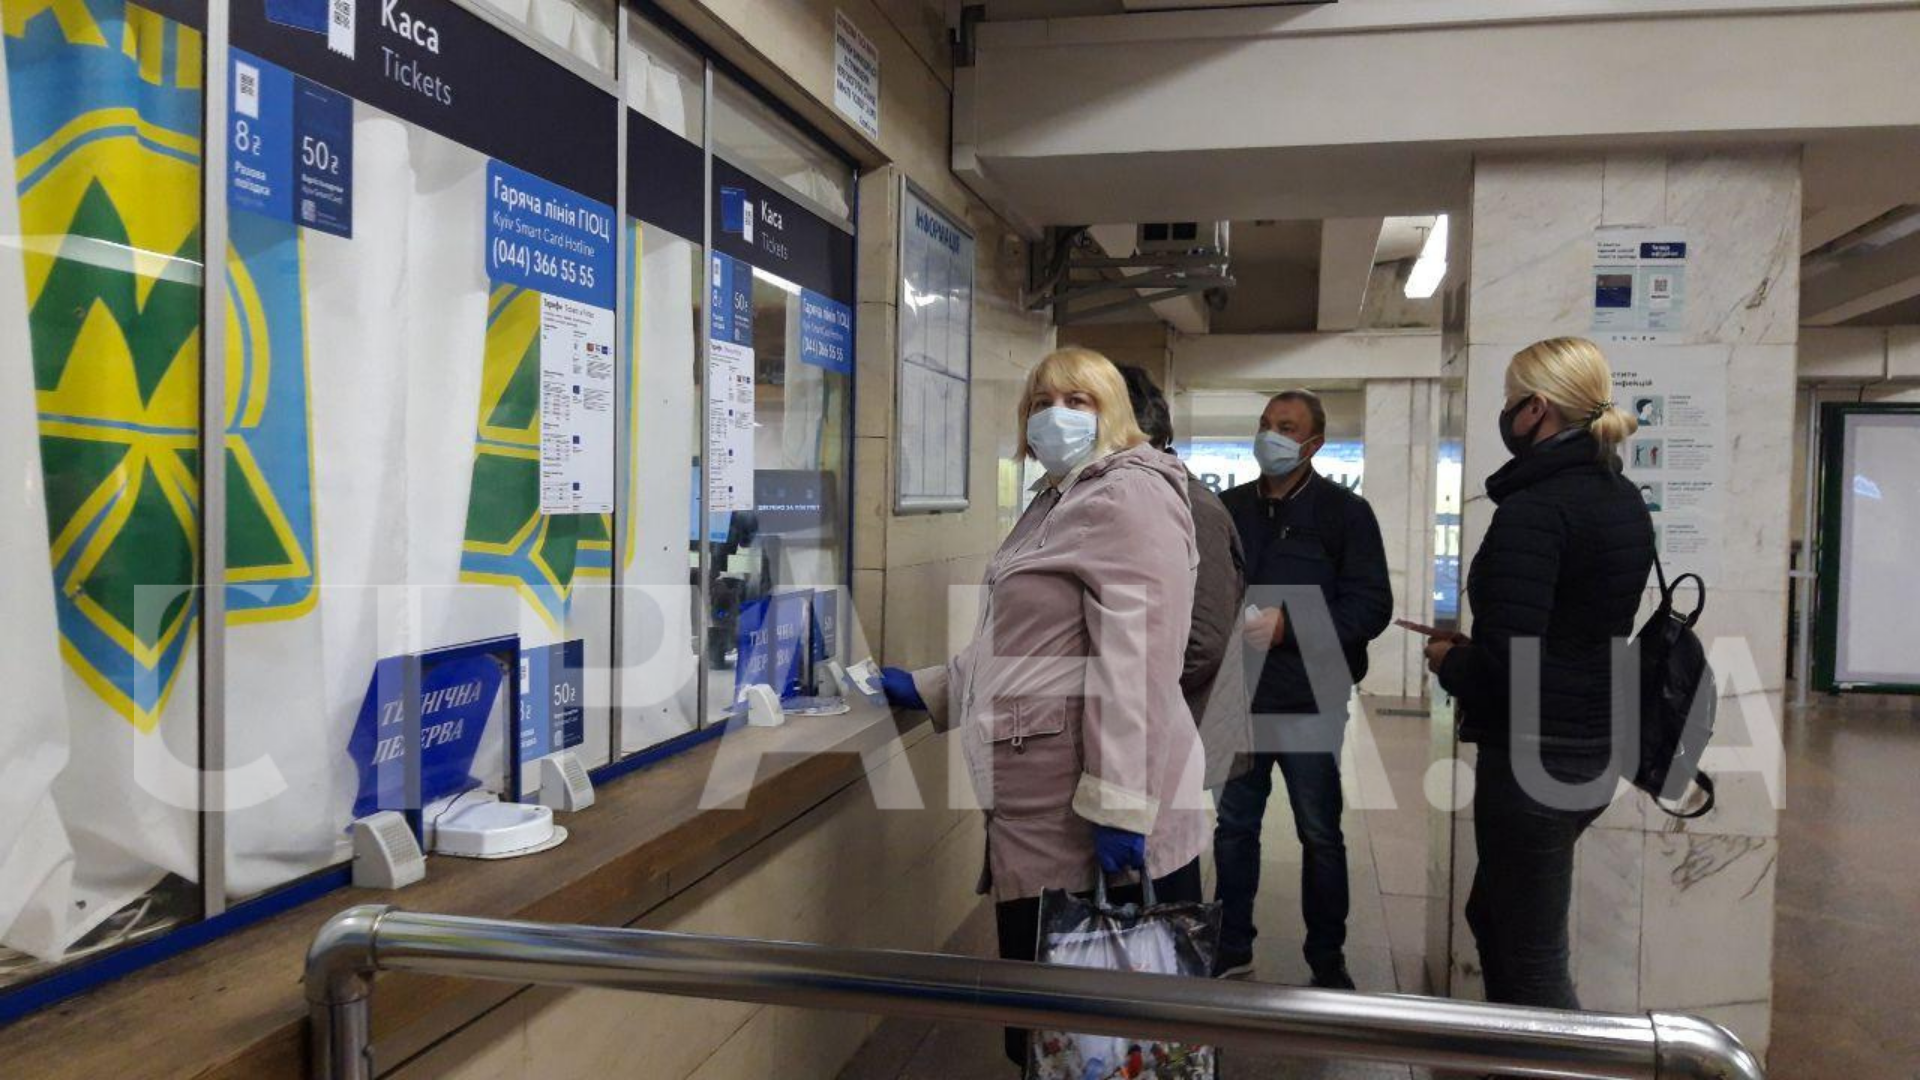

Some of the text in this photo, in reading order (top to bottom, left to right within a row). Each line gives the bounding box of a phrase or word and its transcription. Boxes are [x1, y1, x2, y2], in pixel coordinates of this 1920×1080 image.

[381, 0, 439, 54] Каса
[381, 46, 451, 105] Tickets
[494, 175, 541, 214] Гаряча
[545, 199, 576, 227] лінія
[761, 199, 783, 230] Каса
[493, 210, 595, 257] Kyiv Smart Card Hotline
[762, 231, 788, 260] Tickets
[493, 237, 596, 288] (044) 366 55 55
[381, 681, 483, 727] ТЕНІЧНА
[371, 718, 465, 767] ПЕЕРВА
